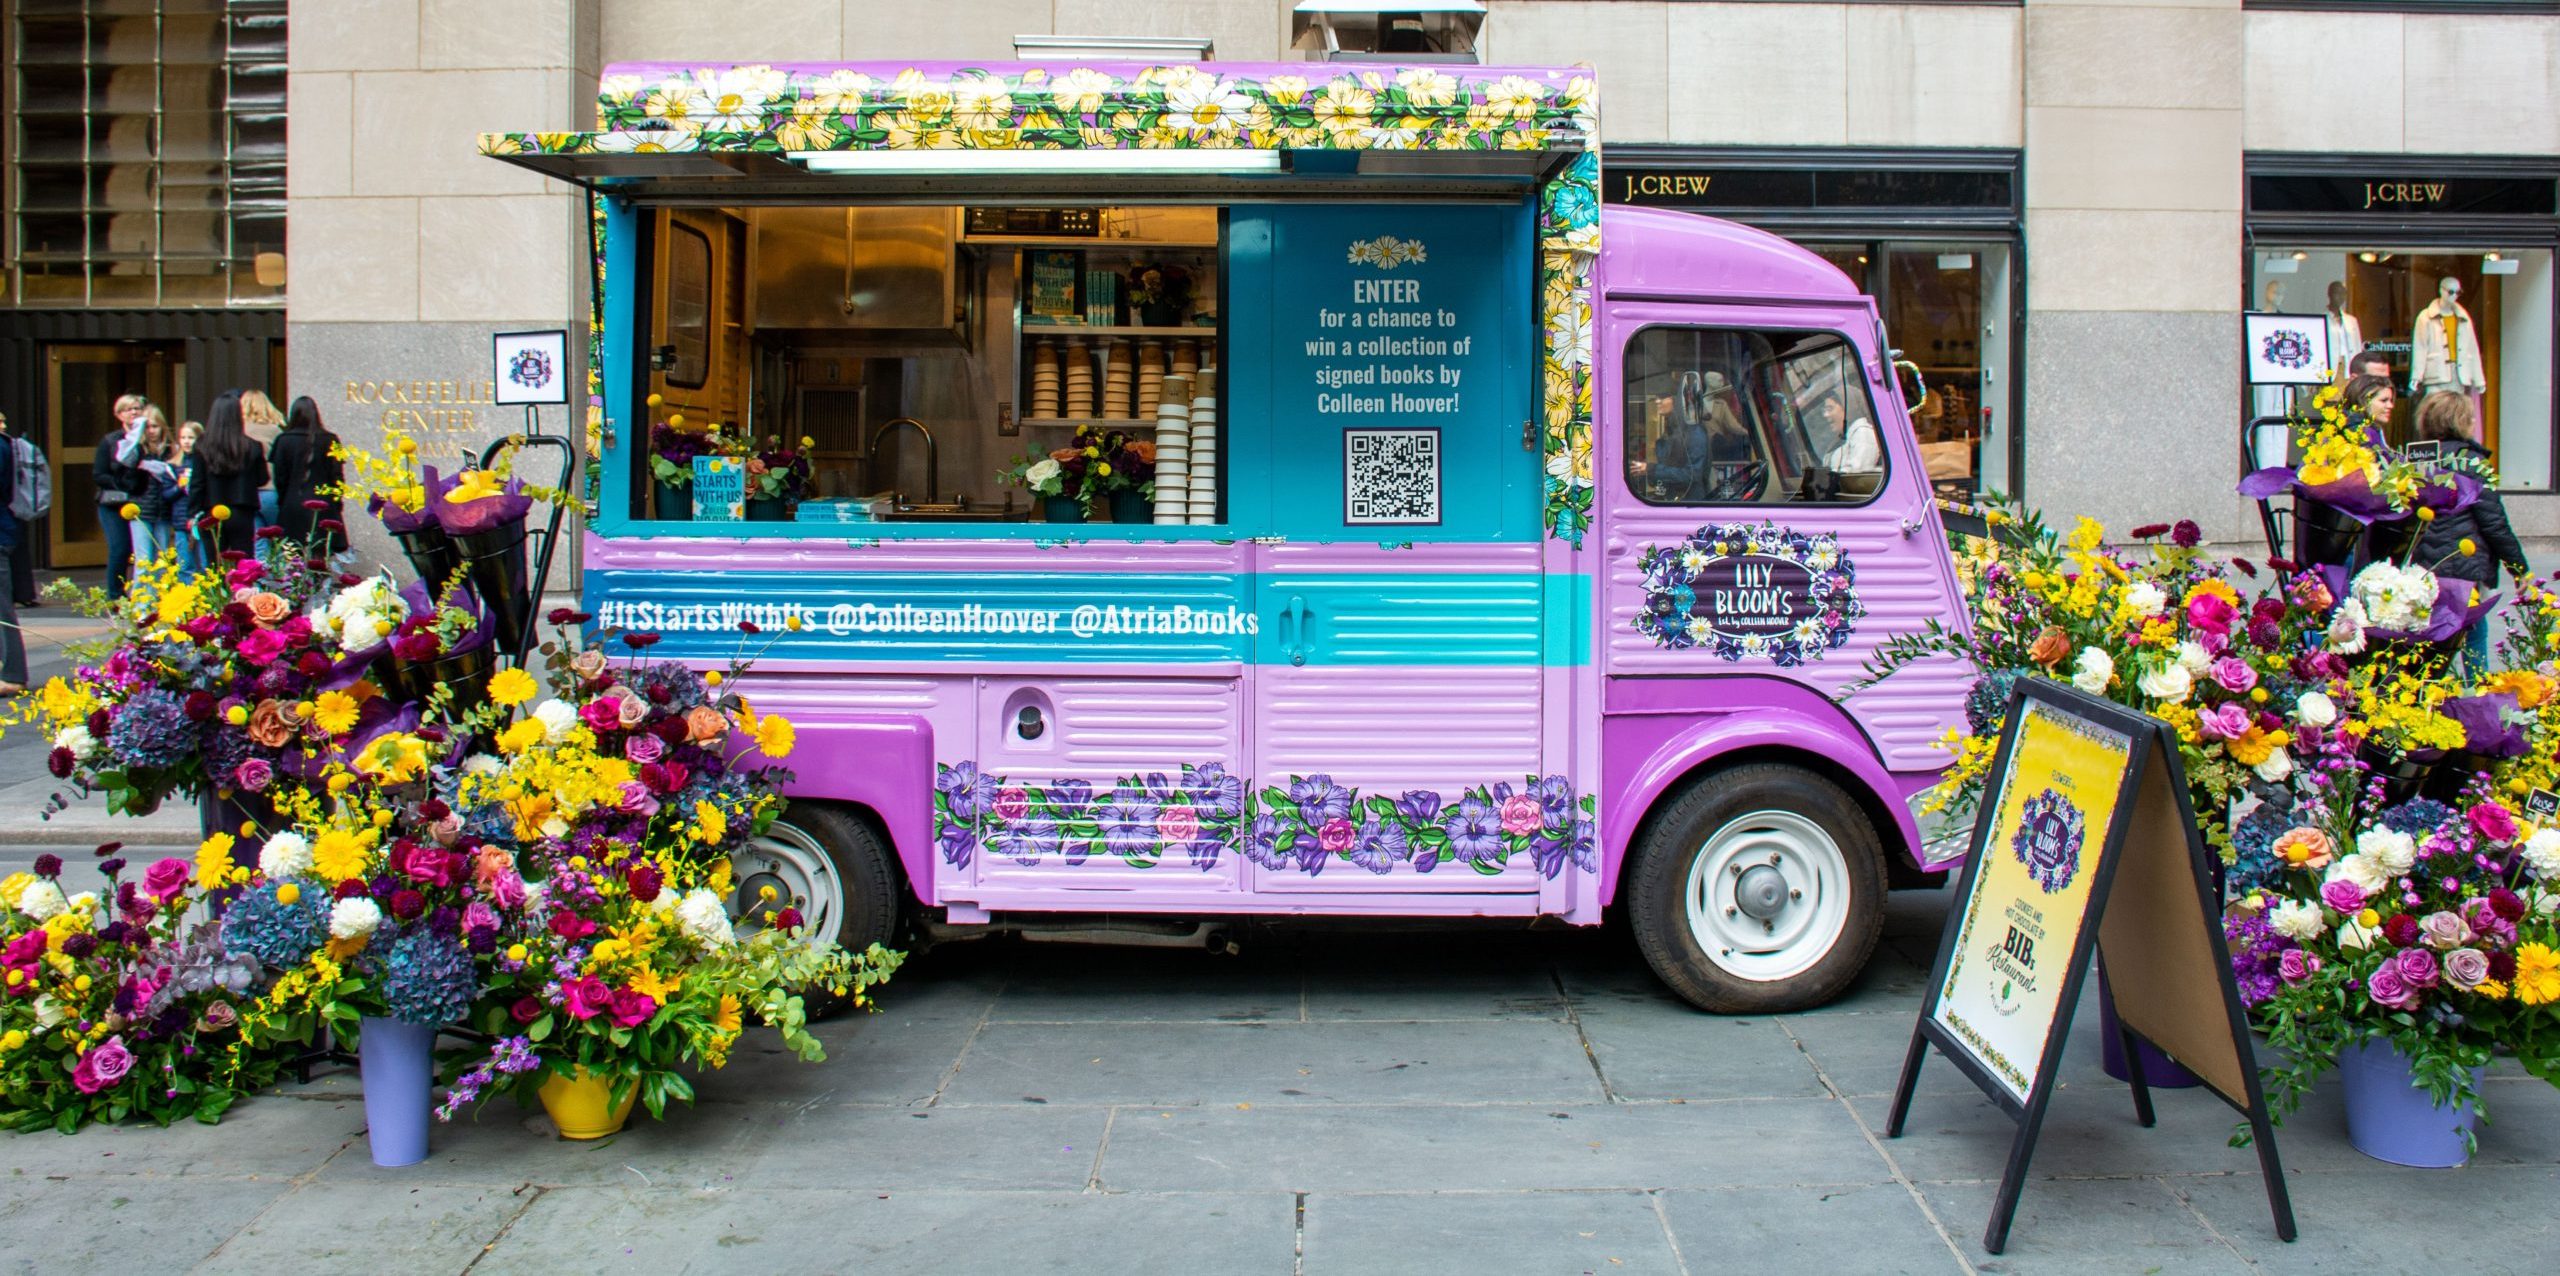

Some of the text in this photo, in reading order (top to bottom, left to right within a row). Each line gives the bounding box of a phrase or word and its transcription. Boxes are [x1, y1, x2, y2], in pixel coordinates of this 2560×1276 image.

[1625, 175, 1711, 202] J.CREW
[2363, 183, 2446, 209] J.CREW
[1354, 279, 1420, 303] ENTER
[1320, 307, 1456, 327] for a chance to
[1305, 336, 1471, 356] win a collection of
[2362, 340, 2412, 352] Cashmere
[1315, 364, 1461, 389] signed books by
[346, 380, 496, 404] ROCKEFELLE
[1318, 392, 1459, 413] Colleen Hoover!
[382, 409, 476, 432] CENTER
[696, 460, 706, 472] IT
[695, 474, 736, 488] STARTS
[695, 490, 741, 503] WITH US
[1736, 563, 1774, 588] LILY
[1715, 585, 1793, 615] BLOOM'S
[827, 602, 1060, 636] @ColleenHoover
[1071, 604, 1259, 638] @AtriaBooks
[2045, 817, 2061, 838] LILY
[1985, 943, 2037, 993] Restaurant
